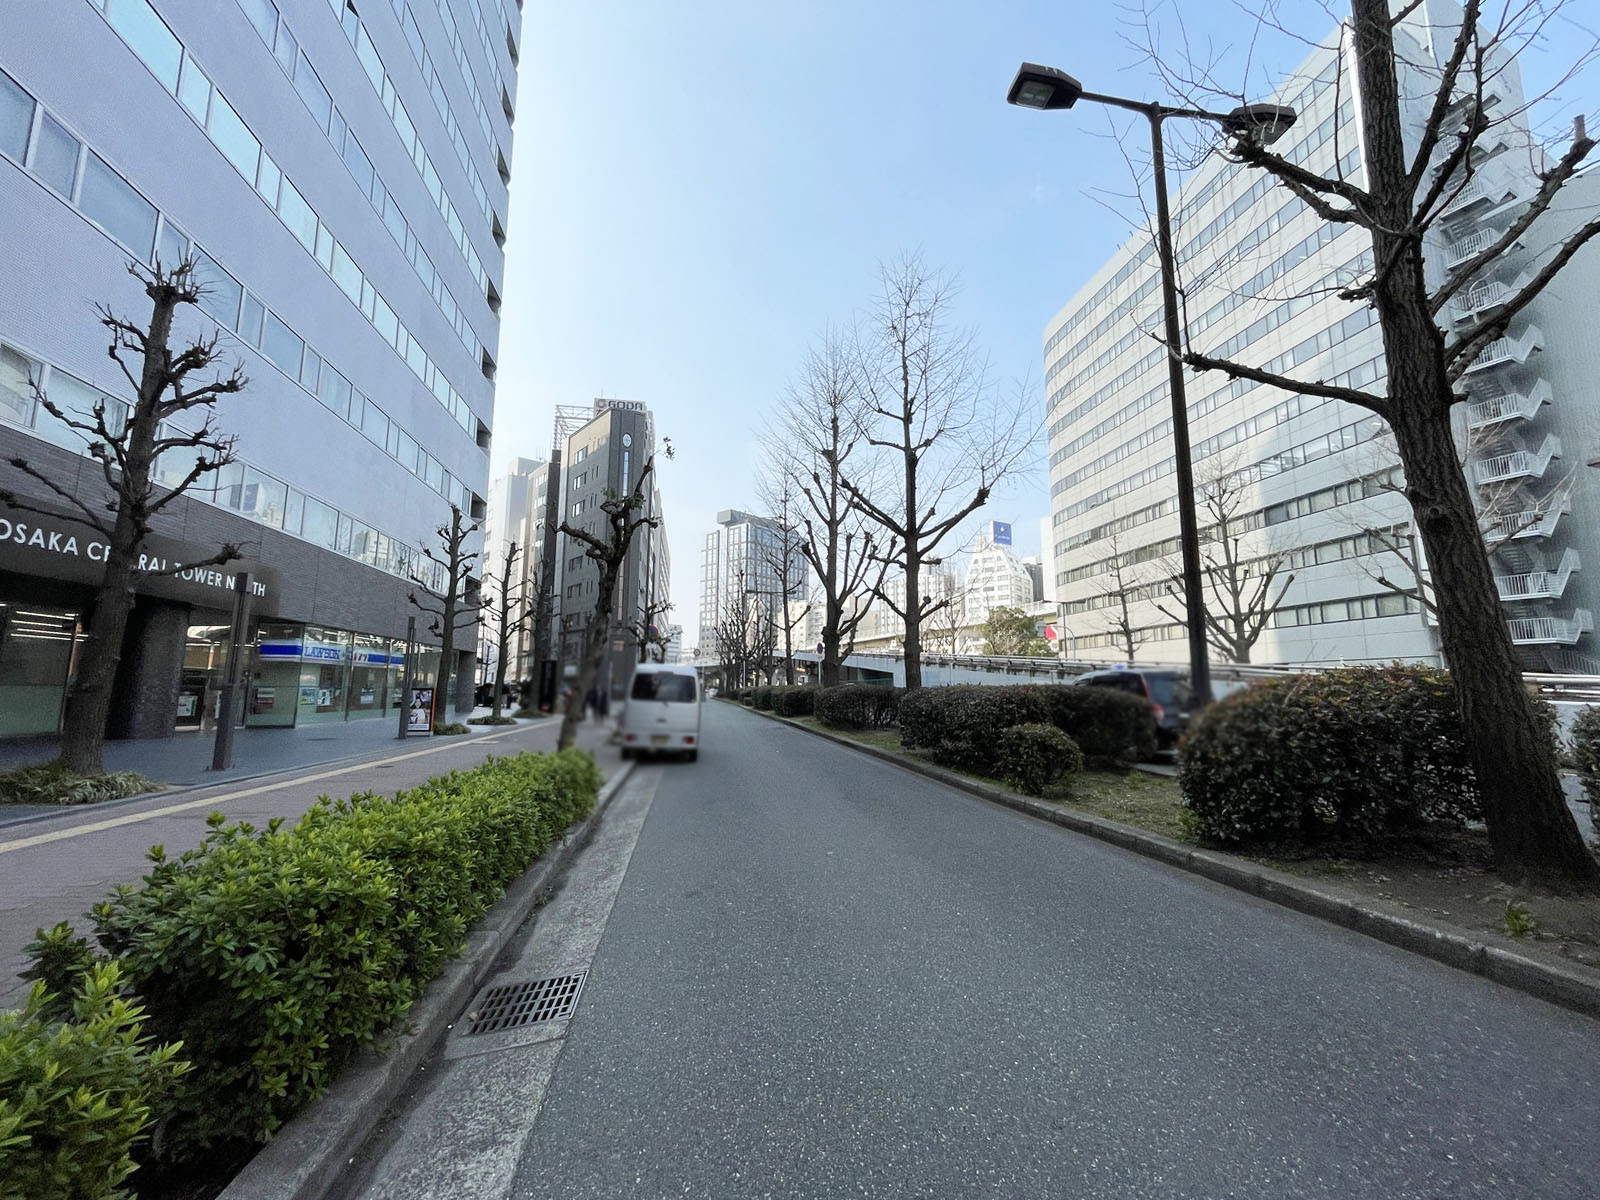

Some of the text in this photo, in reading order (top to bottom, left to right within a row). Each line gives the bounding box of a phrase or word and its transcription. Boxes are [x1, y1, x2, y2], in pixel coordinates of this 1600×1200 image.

[0, 518, 266, 597] OSAKA CERAL TOWER NTH
[304, 646, 341, 660] LAWSON
